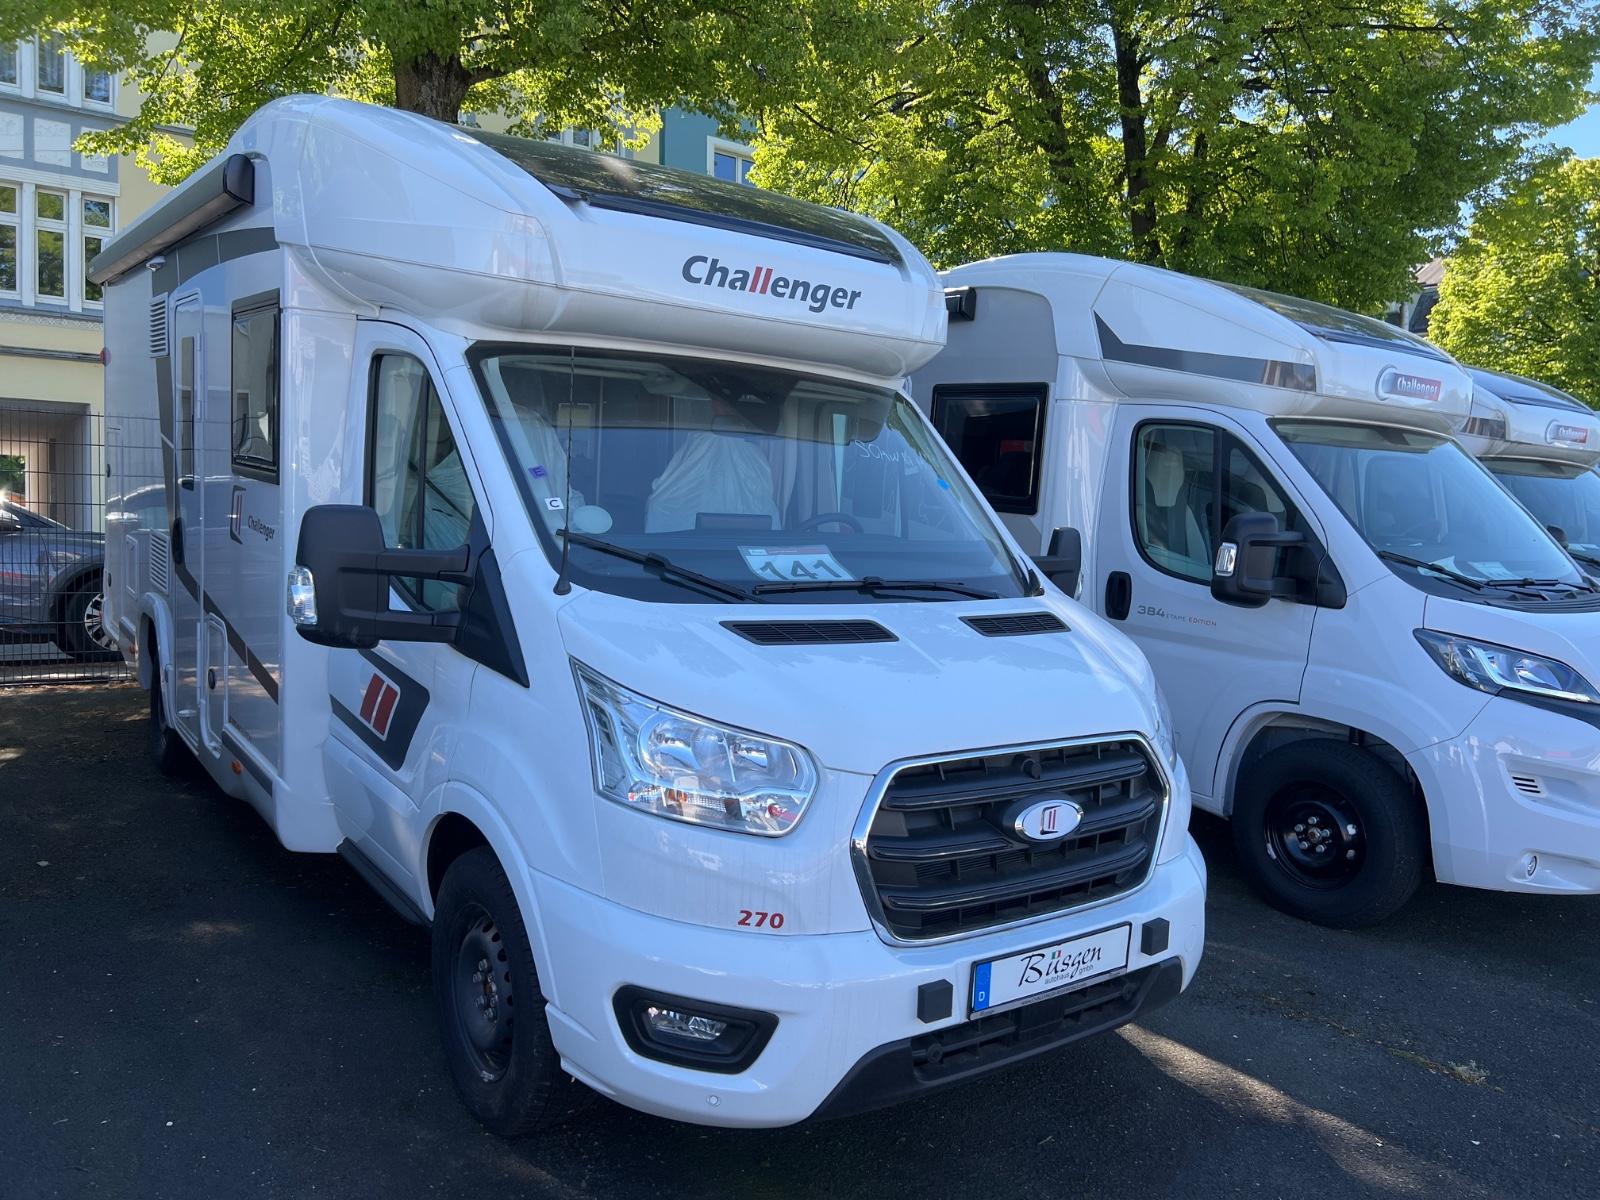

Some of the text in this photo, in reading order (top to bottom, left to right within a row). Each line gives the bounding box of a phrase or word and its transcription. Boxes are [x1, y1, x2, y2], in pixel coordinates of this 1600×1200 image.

[681, 255, 862, 313] Challenger
[1397, 376, 1438, 393] Challenger
[549, 499, 560, 508] C
[248, 515, 275, 541] Challenger
[760, 559, 842, 580] 141
[1137, 605, 1165, 617] 384
[1188, 616, 1217, 626] EDITION
[737, 910, 784, 929] 270
[978, 991, 986, 1002] D
